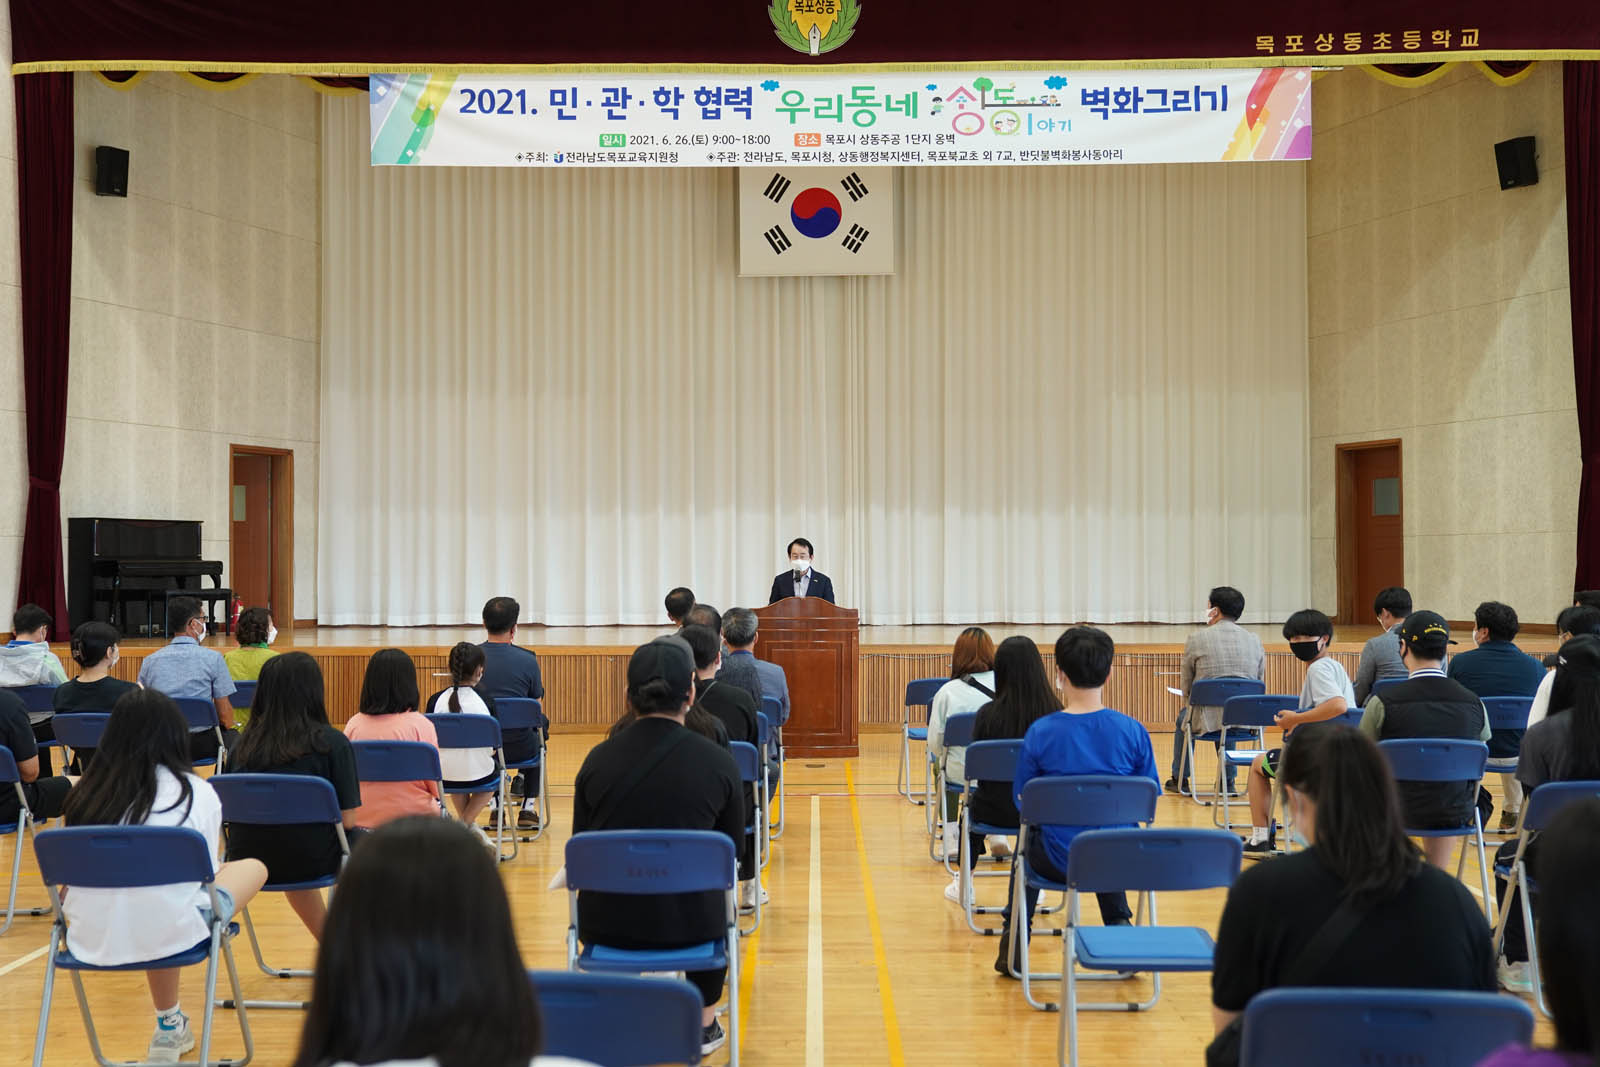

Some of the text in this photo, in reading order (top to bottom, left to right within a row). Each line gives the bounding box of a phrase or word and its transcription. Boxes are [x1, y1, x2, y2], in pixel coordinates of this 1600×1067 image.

[1255, 28, 1480, 53] 목포상동초등학교
[459, 88, 538, 115] 2021.
[694, 86, 753, 120] 협력
[775, 86, 918, 128] 우리동네
[1081, 84, 1228, 121] 벽화그리기
[601, 134, 623, 146] 일시
[712, 134, 771, 145] 9:00~18:00
[796, 133, 955, 146] 장소 목포시 상동주공 1단지 옹벽
[565, 152, 679, 163] 전라남도목포교육지원청
[743, 151, 787, 163] 전라남도,
[791, 151, 835, 163] 목포시청,
[838, 151, 924, 163] 상동행정복지센터,
[927, 151, 979, 162] 목포북교초
[982, 150, 993, 162] 외
[997, 150, 1016, 162] 7교,
[1019, 149, 1123, 161] 반딧불벽화봉사동아리
